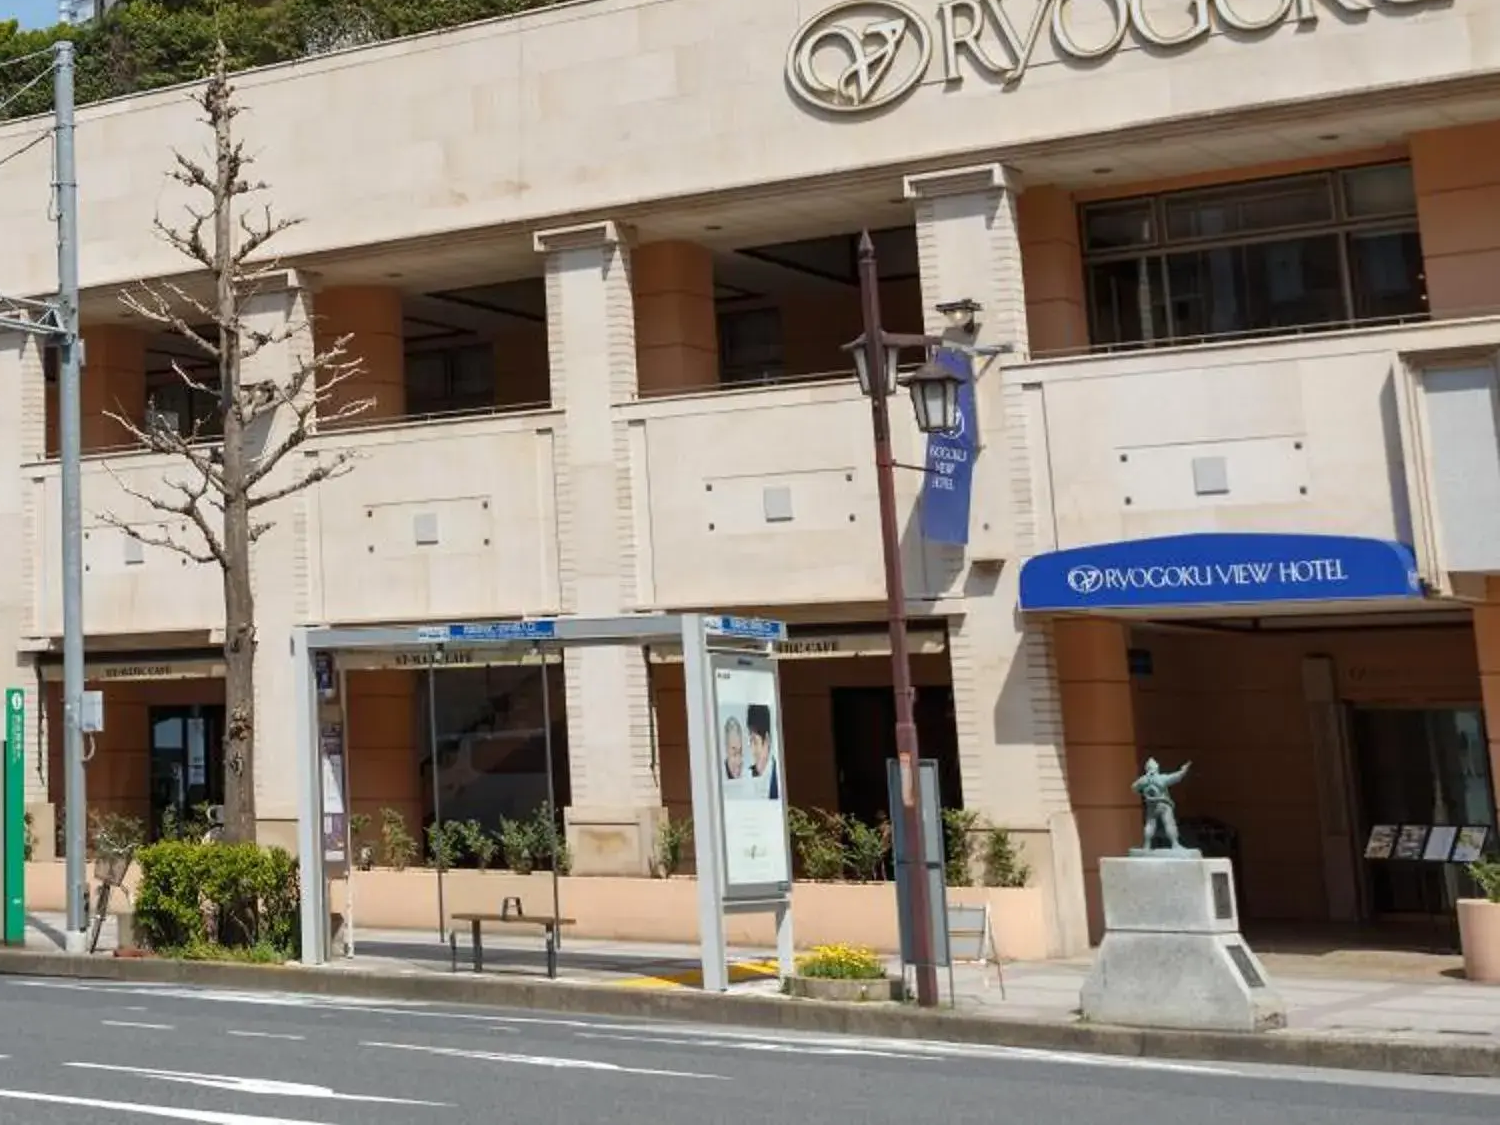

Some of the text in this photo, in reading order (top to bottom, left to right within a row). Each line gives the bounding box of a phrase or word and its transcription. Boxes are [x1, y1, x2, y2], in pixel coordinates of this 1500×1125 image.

[1105, 558, 1348, 591] RYOGOKU VIEW HOTEL
